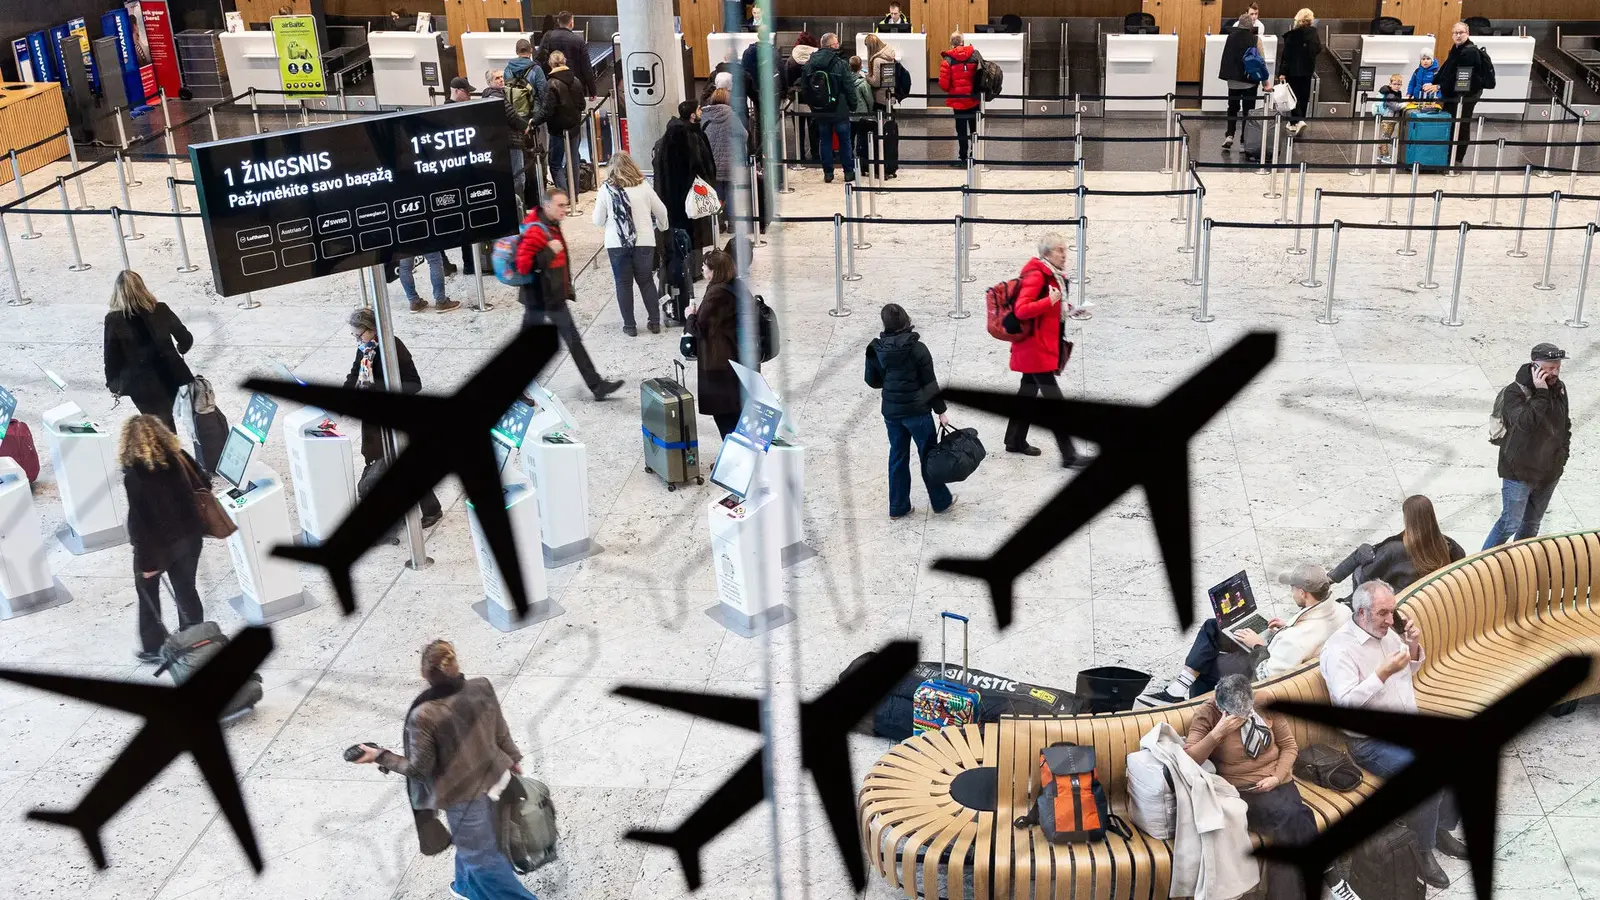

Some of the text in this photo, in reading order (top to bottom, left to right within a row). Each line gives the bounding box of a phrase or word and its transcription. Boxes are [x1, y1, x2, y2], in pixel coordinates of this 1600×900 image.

[115, 15, 129, 58] RYANAIR
[34, 39, 48, 82] YANAIR
[410, 127, 476, 154] 1st STEP
[223, 151, 333, 187] 1 ŽINGSNIS
[414, 151, 493, 174] Tag your bag
[228, 167, 394, 208] Pažymėkite savo bagažą
[470, 188, 493, 199] airBaltic
[399, 200, 421, 214] SAS
[280, 227, 302, 235] Austrian
[329, 217, 348, 226] SWISS
[246, 233, 270, 242] Lufthansa
[956, 670, 1020, 692] MYSTIC
